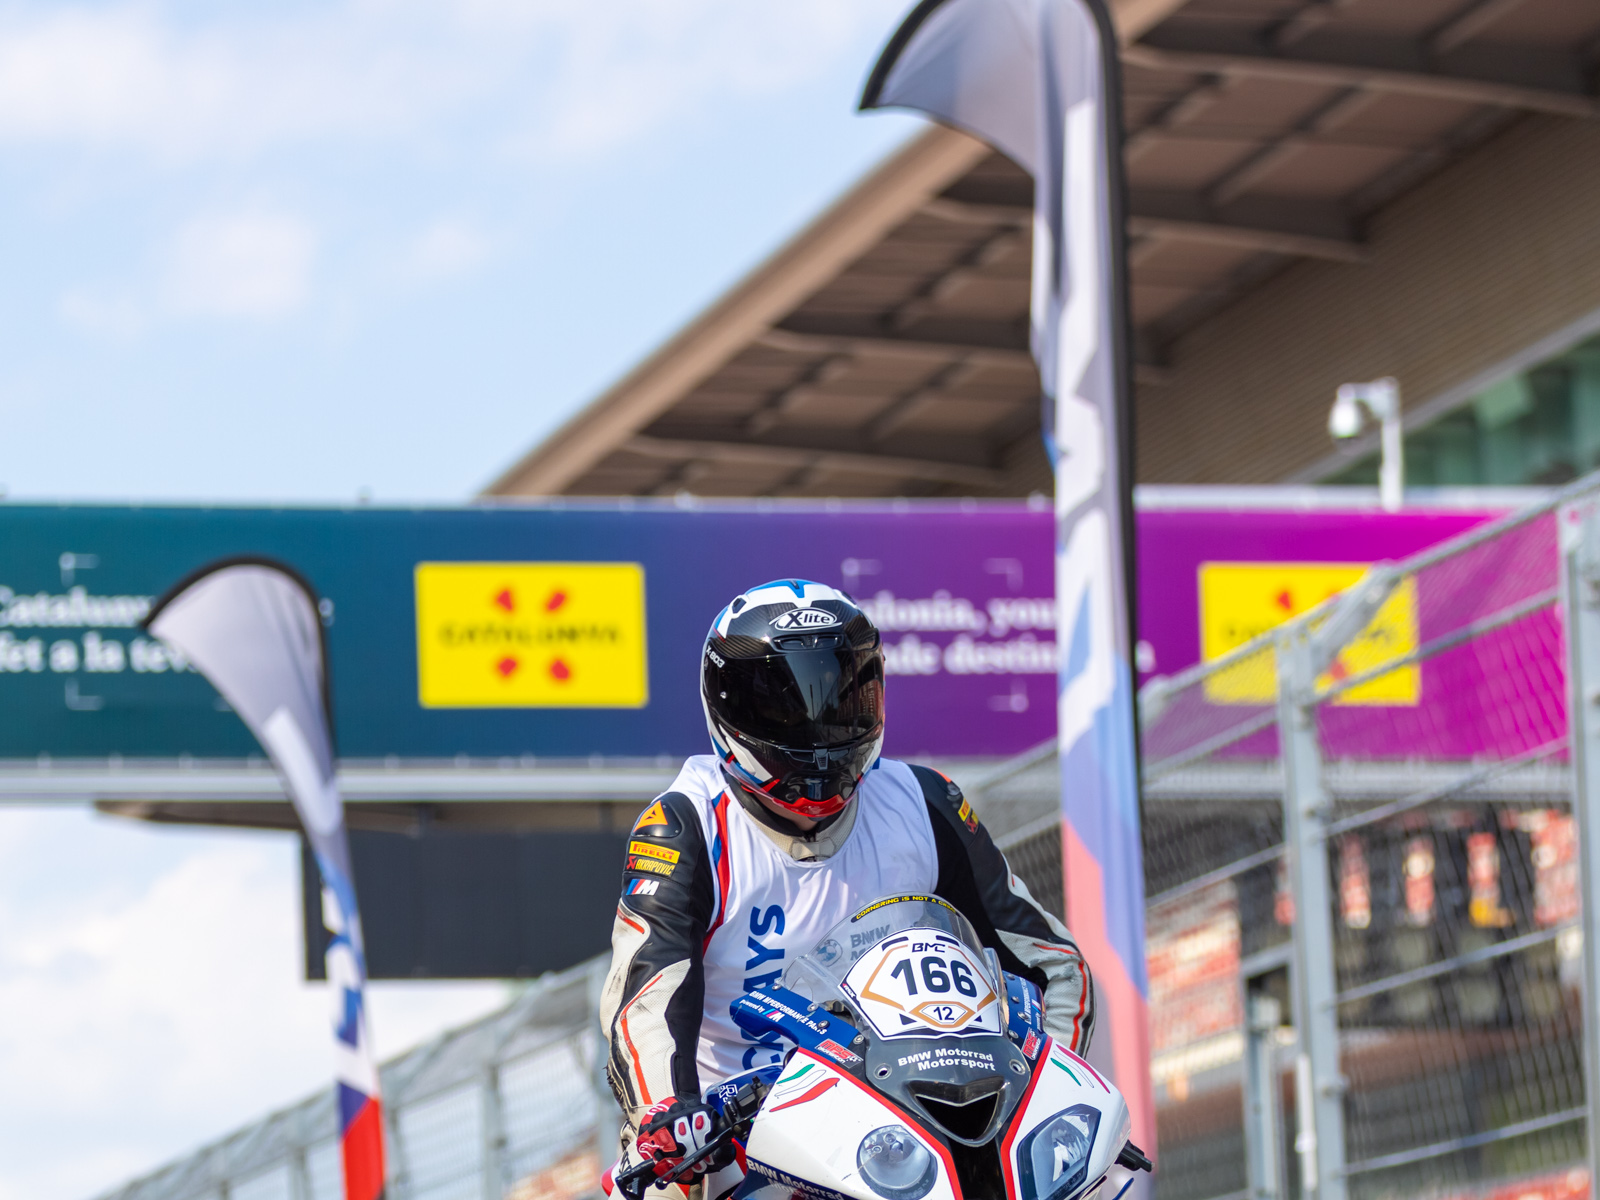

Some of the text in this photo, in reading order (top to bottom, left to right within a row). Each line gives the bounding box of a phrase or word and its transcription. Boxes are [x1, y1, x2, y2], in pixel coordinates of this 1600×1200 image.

[786, 611, 831, 627] X-lite
[50, 640, 78, 673] a
[633, 843, 675, 860] PIRELLI
[856, 898, 900, 920] CORNERING
[742, 904, 786, 995] AYS
[911, 942, 946, 953] BMC
[890, 956, 978, 997] 166
[933, 1006, 955, 1021] 12
[805, 1020, 828, 1035] PAS
[897, 1047, 994, 1067] BMW Motorrad
[917, 1057, 996, 1072] Motorsport
[746, 1158, 779, 1181] BMW
